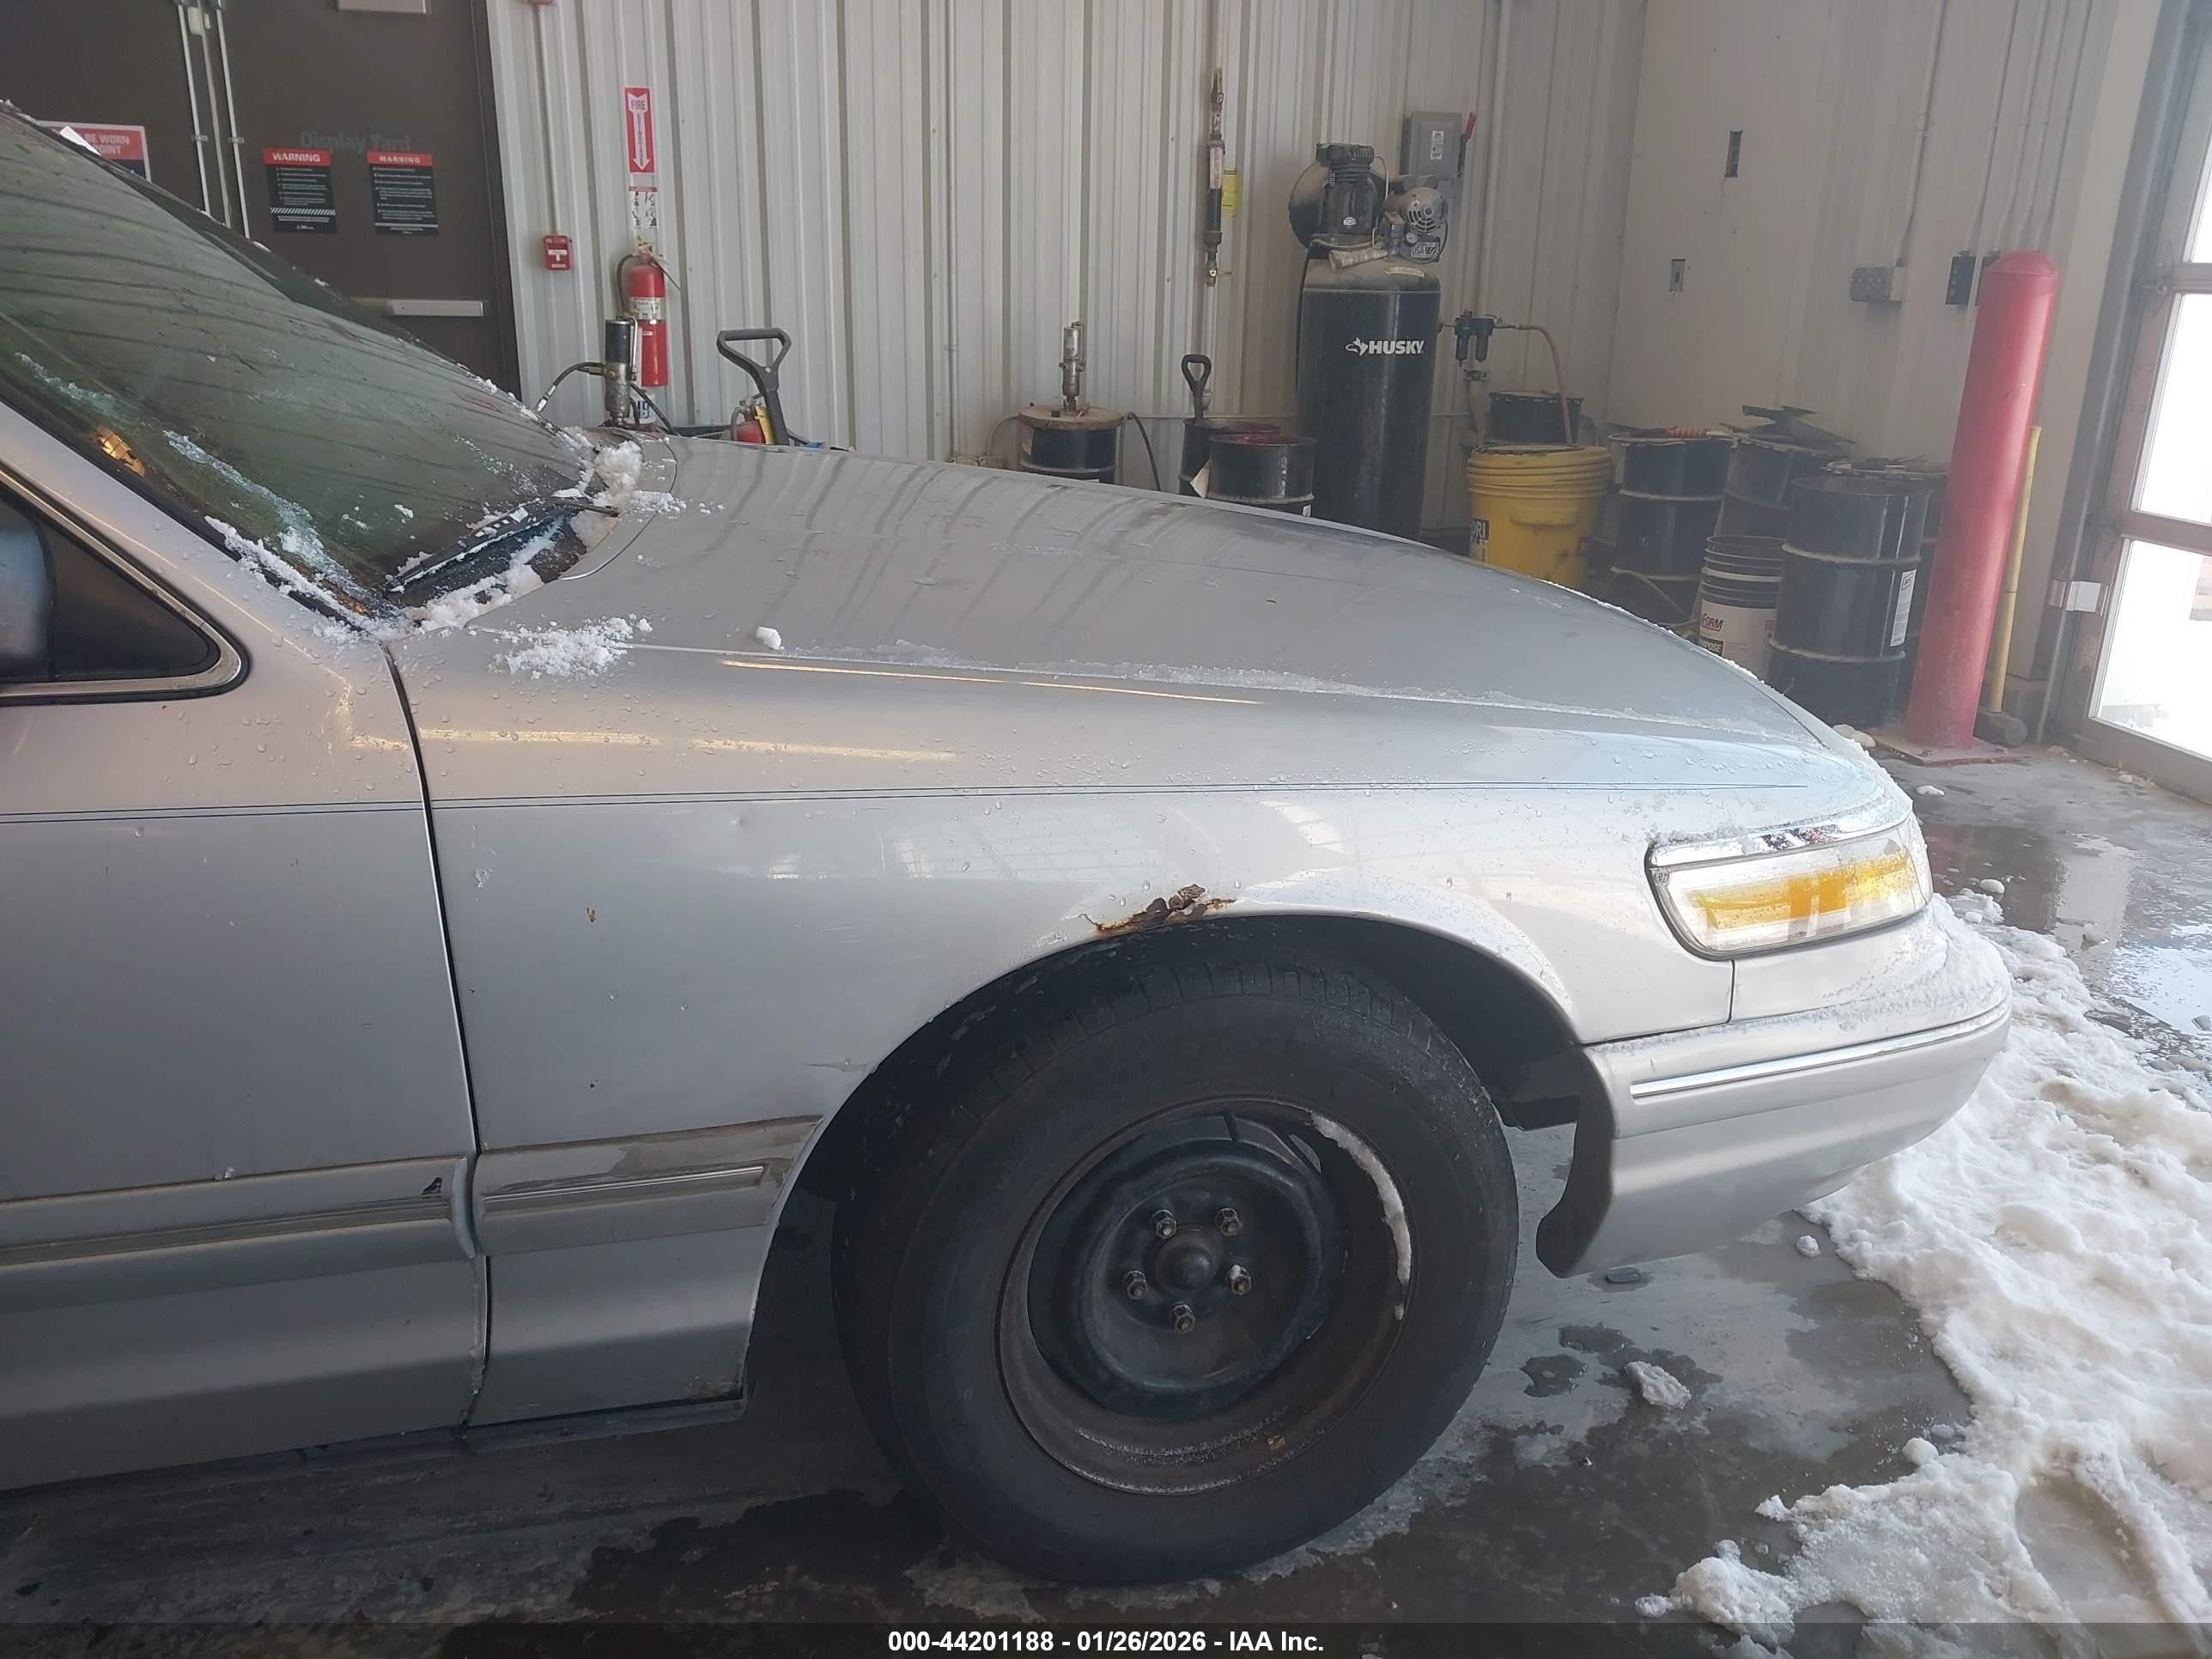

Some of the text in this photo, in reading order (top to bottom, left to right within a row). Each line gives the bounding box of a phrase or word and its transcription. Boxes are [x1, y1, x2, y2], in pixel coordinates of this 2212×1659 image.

[300, 131, 411, 154] Display Yard
[272, 153, 321, 162] WARNING
[379, 155, 421, 164] WARNING
[1369, 340, 1425, 355] HUSKY
